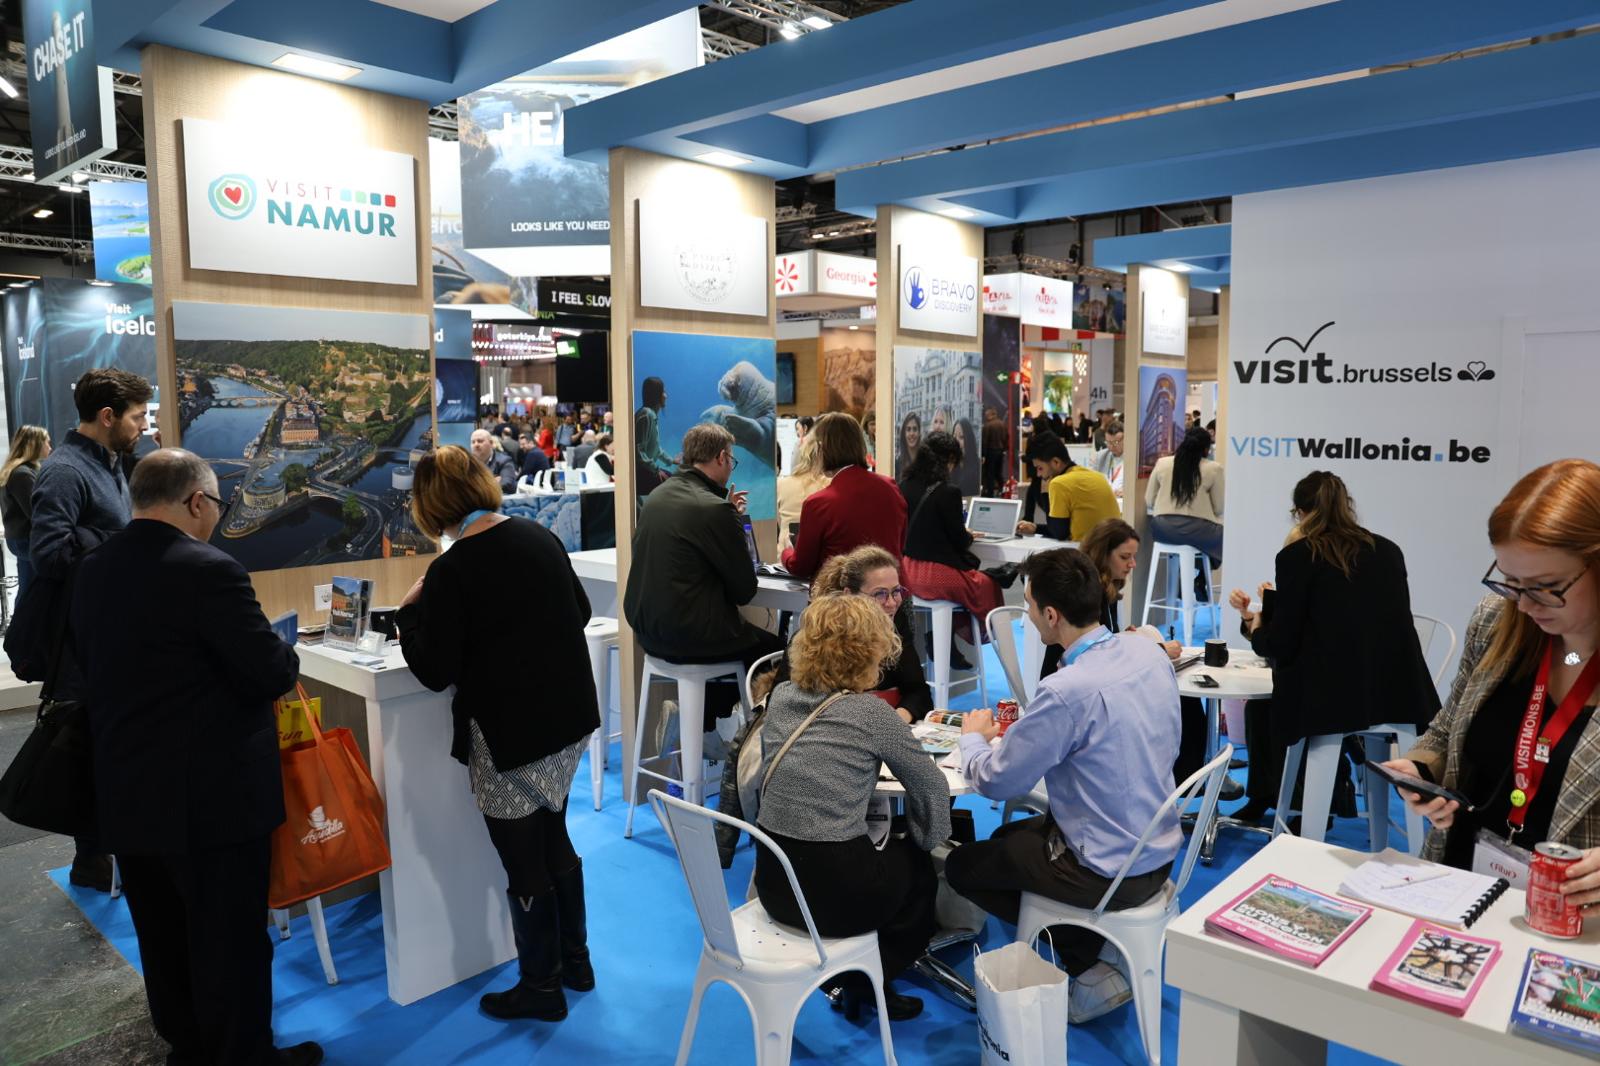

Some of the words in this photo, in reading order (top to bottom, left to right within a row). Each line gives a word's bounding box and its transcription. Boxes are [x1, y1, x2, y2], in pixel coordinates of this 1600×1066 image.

[33, 22, 72, 82] CHASE
[72, 11, 85, 53] IT
[266, 178, 333, 201] VISIT
[267, 199, 397, 238] NAMUR
[511, 222, 542, 232] LOOKS
[544, 221, 564, 231] LIKE
[566, 220, 585, 231] YOU
[587, 220, 611, 230] NEED
[826, 267, 867, 285] Georgia
[558, 293, 584, 306] FEEL
[932, 279, 975, 301] BRAVO
[105, 303, 132, 315] Visit
[1516, 685, 1545, 770] VISITMONS.BE
